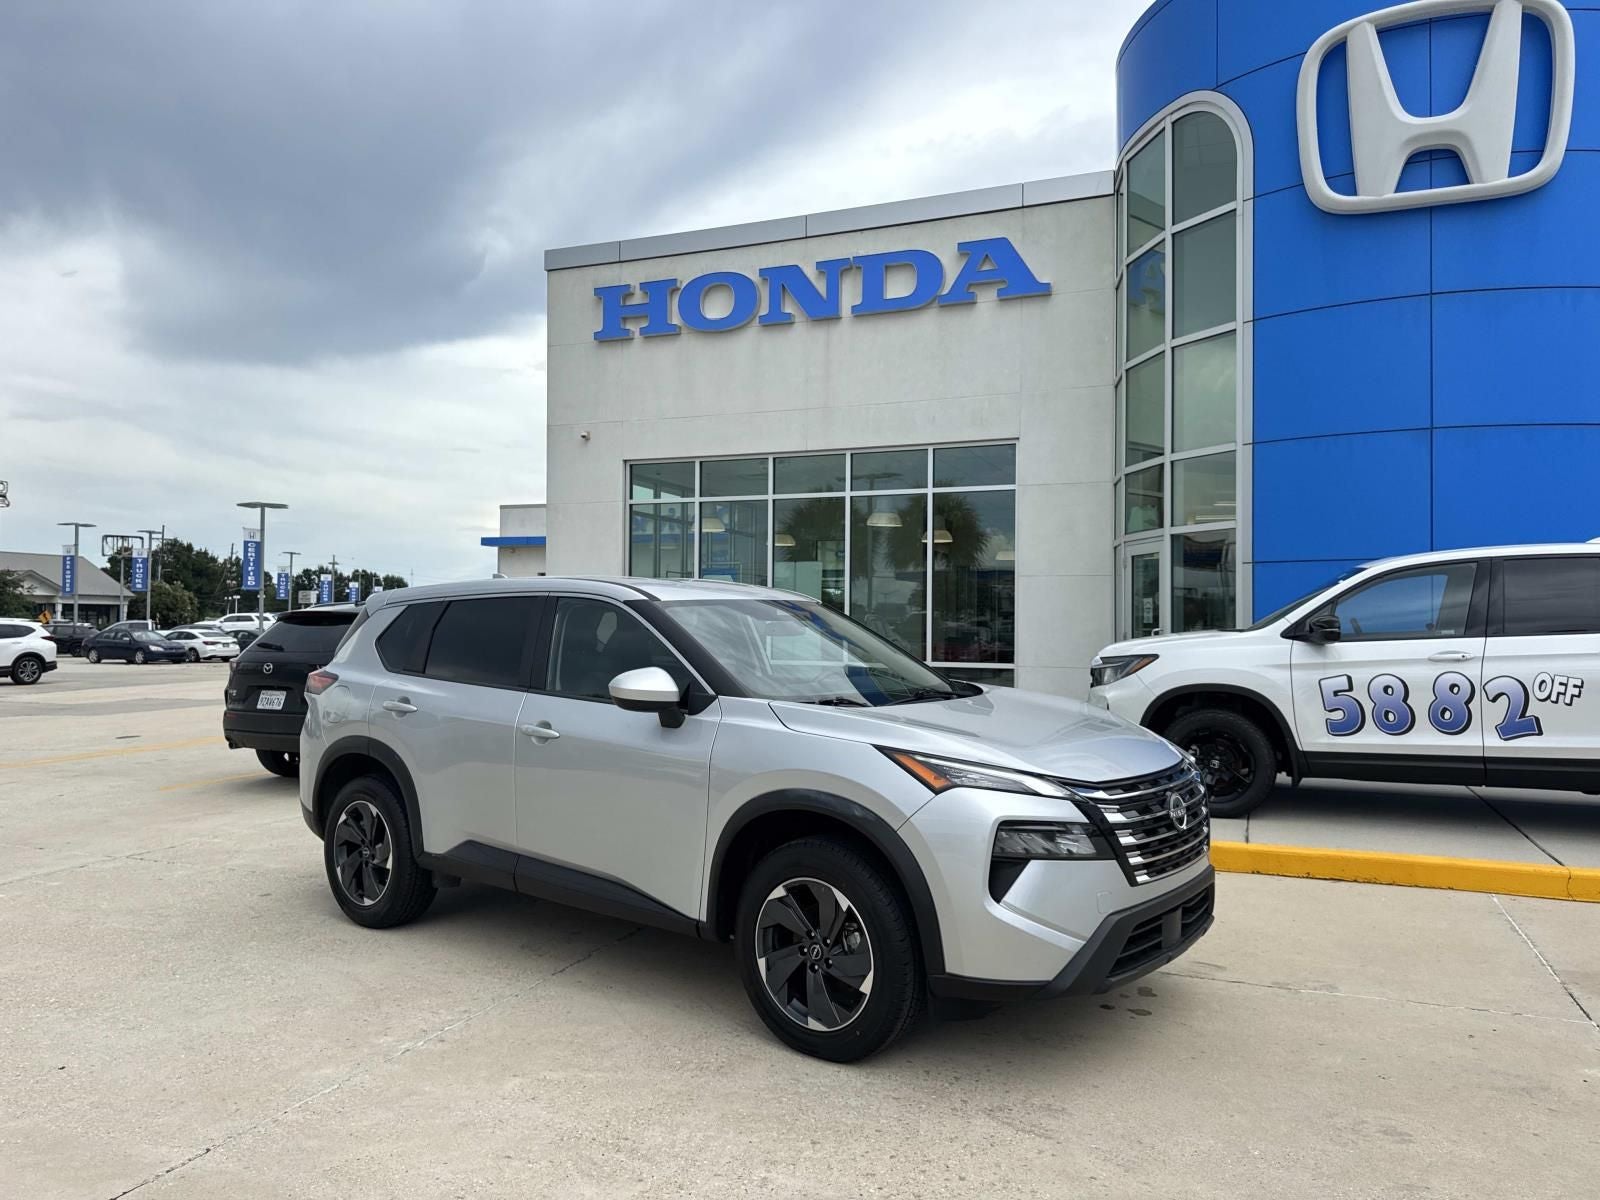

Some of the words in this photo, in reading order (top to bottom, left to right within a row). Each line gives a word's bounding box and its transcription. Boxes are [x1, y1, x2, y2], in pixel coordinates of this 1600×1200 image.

[593, 236, 1053, 341] HONDA
[135, 558, 143, 589] TRUCKS
[247, 542, 256, 586] CERTIFIED
[1318, 671, 1544, 741] 5882
[1532, 672, 1584, 706] OFF
